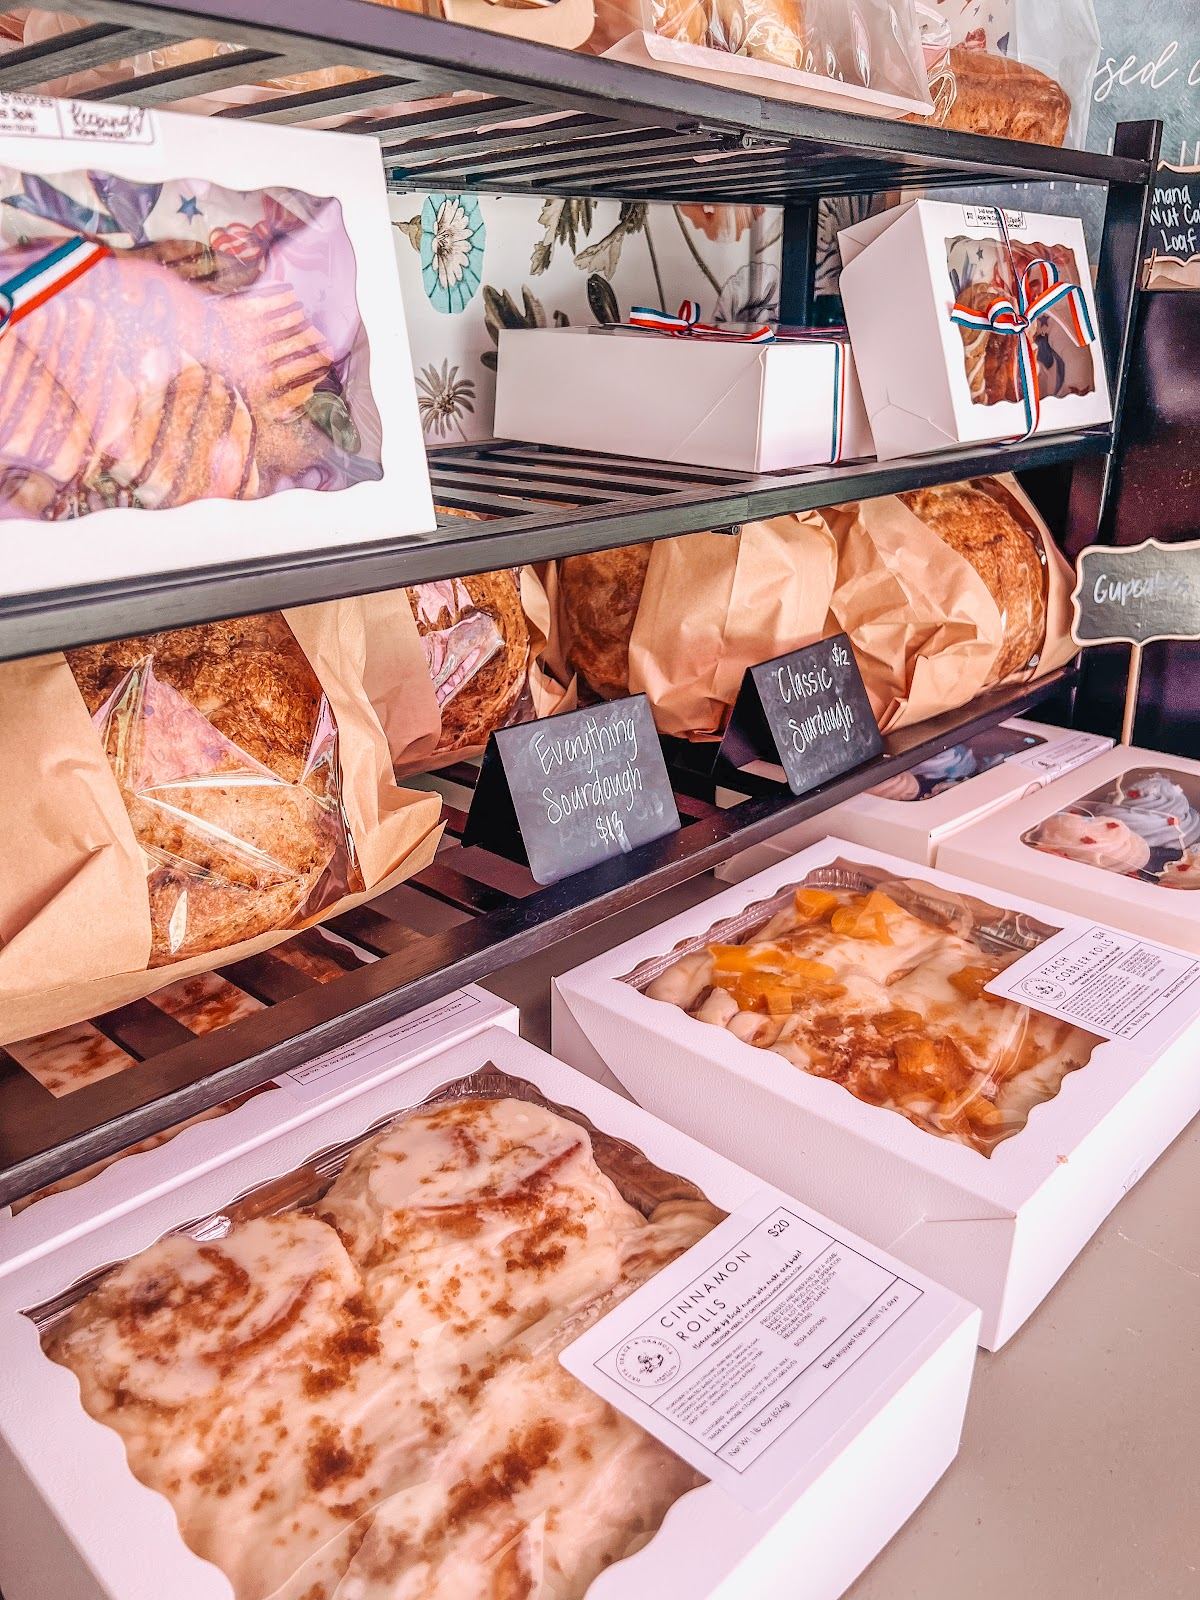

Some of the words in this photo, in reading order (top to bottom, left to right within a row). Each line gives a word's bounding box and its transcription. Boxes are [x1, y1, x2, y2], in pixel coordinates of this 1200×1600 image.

[1150, 205, 1179, 229] Nut
[1160, 227, 1197, 253] Loaf
[831, 642, 850, 668] $12
[778, 664, 832, 704] Classic
[788, 697, 854, 753] Sourdough
[534, 717, 638, 775] Everything
[542, 760, 643, 824] Sourdough
[1040, 956, 1069, 975] PEACH
[1055, 956, 1091, 981] COBBLER
[1088, 939, 1113, 955] ROLLS
[767, 1219, 789, 1237] $20
[660, 1250, 750, 1327] CINNAMON
[779, 1304, 793, 1315] FOOD
[791, 1279, 819, 1303] PRODUCTION
[817, 1257, 841, 1279] OPERATION
[796, 1290, 814, 1308] SUBJECT
[675, 1298, 725, 1341] ROLLS
[720, 1318, 729, 1326] by
[822, 1356, 836, 1368] Best
[835, 1338, 855, 1357] enjoyed
[852, 1326, 866, 1338] fresh
[867, 1313, 880, 1326] within
[886, 1295, 898, 1306] days
[760, 1416, 772, 1427] 6oz
[770, 1399, 790, 1418] (624g)
